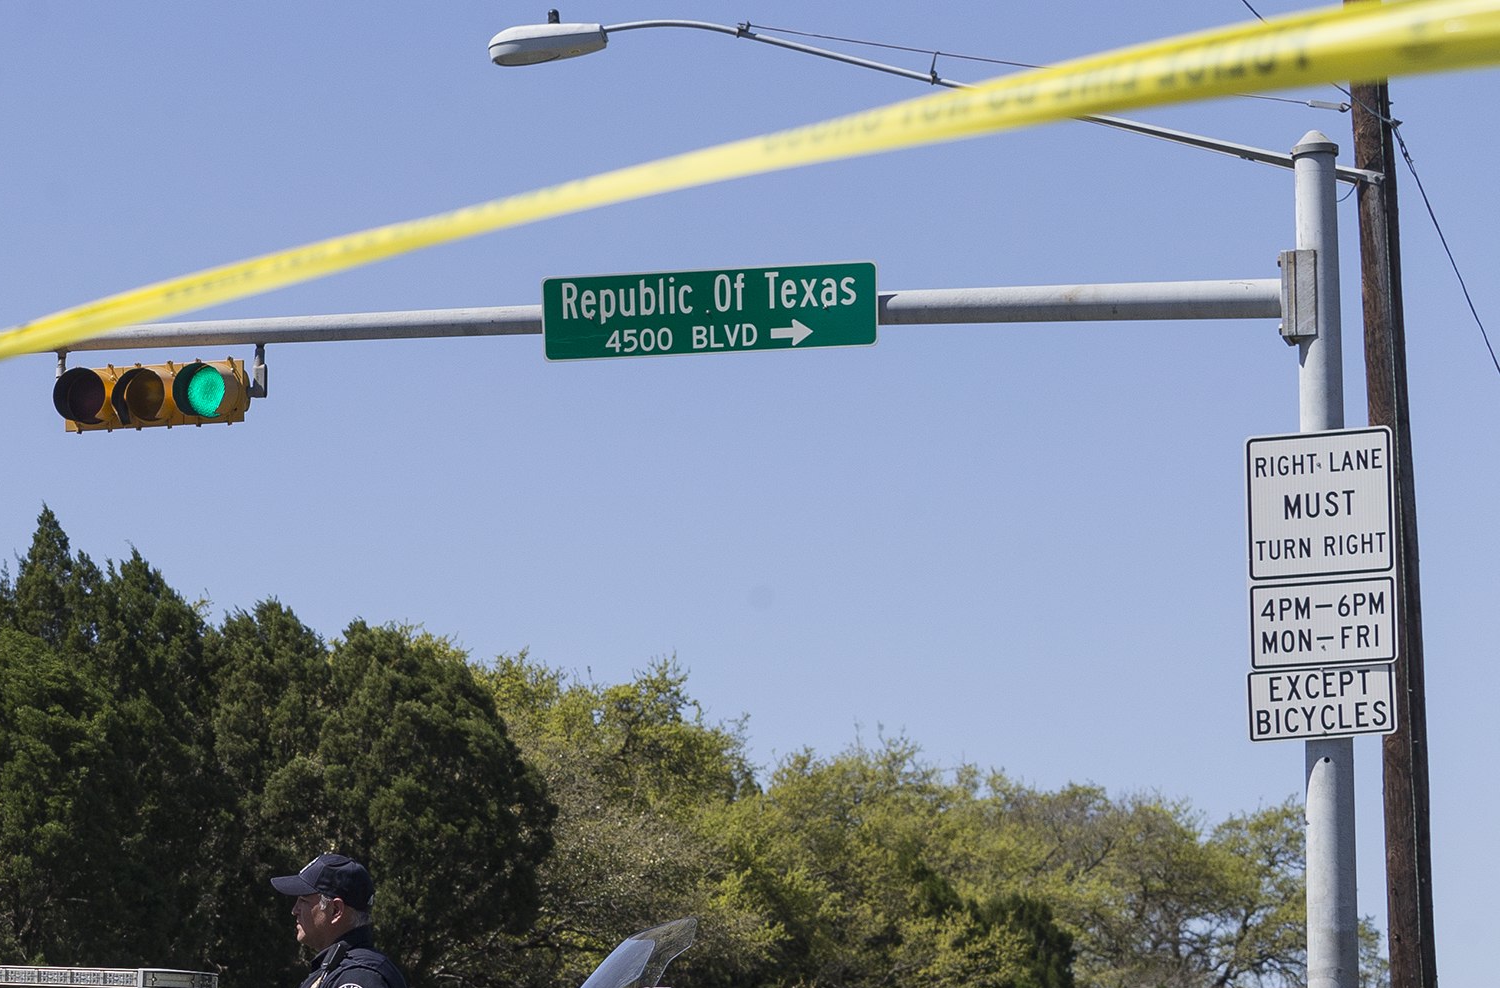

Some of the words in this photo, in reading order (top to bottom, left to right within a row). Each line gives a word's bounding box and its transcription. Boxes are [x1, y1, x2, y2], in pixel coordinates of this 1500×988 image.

[562, 277, 693, 325] Republic
[714, 273, 745, 312] Of
[765, 271, 857, 310] Texas
[605, 327, 673, 352] 4500
[692, 323, 758, 349] BLVD
[1255, 453, 1317, 478] RIGHT
[1329, 448, 1383, 473] LANE
[1284, 490, 1355, 520] MUST
[1256, 537, 1311, 561] TURN
[1323, 532, 1386, 556] RIGHT
[1269, 669, 1371, 702] EXCEPT
[1256, 700, 1387, 735] BICYCLES
